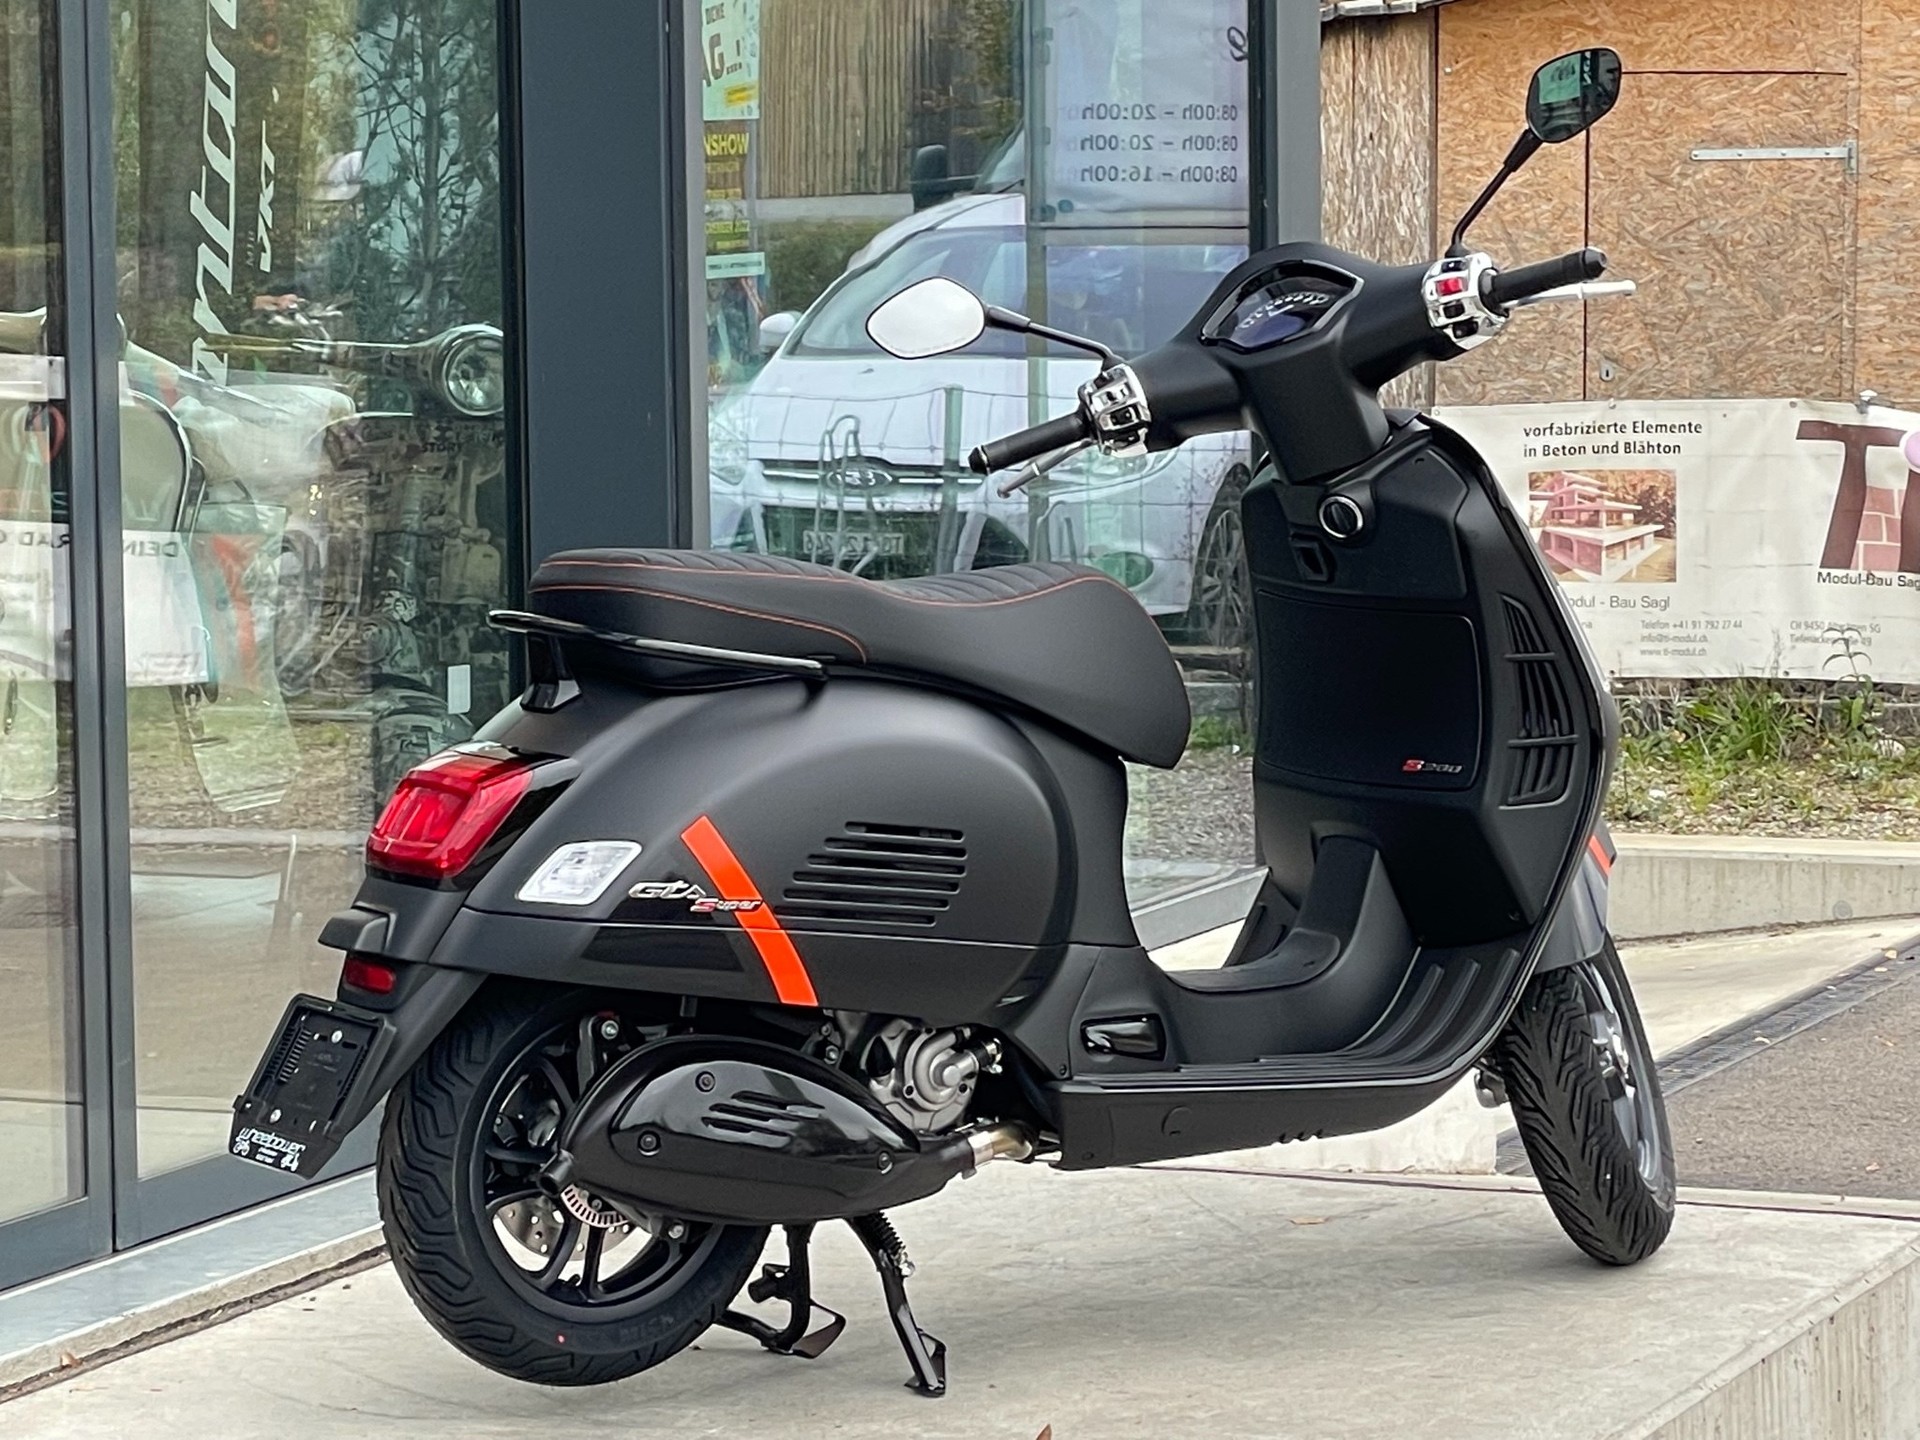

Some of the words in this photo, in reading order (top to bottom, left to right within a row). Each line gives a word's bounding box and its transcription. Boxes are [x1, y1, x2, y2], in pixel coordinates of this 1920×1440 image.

[1523, 421, 1627, 437] vorfabrizierte
[1632, 420, 1703, 434] Elemente
[1523, 444, 1537, 458] in
[1542, 443, 1587, 457] Beton
[1592, 441, 1619, 454] und
[1624, 440, 1682, 455] Blähton
[1816, 571, 1893, 587] Modul-Bau
[1609, 596, 1636, 608] Bau
[1641, 596, 1670, 611] Sagl
[1640, 620, 1670, 630] Telefon
[690, 897, 761, 913] Super
